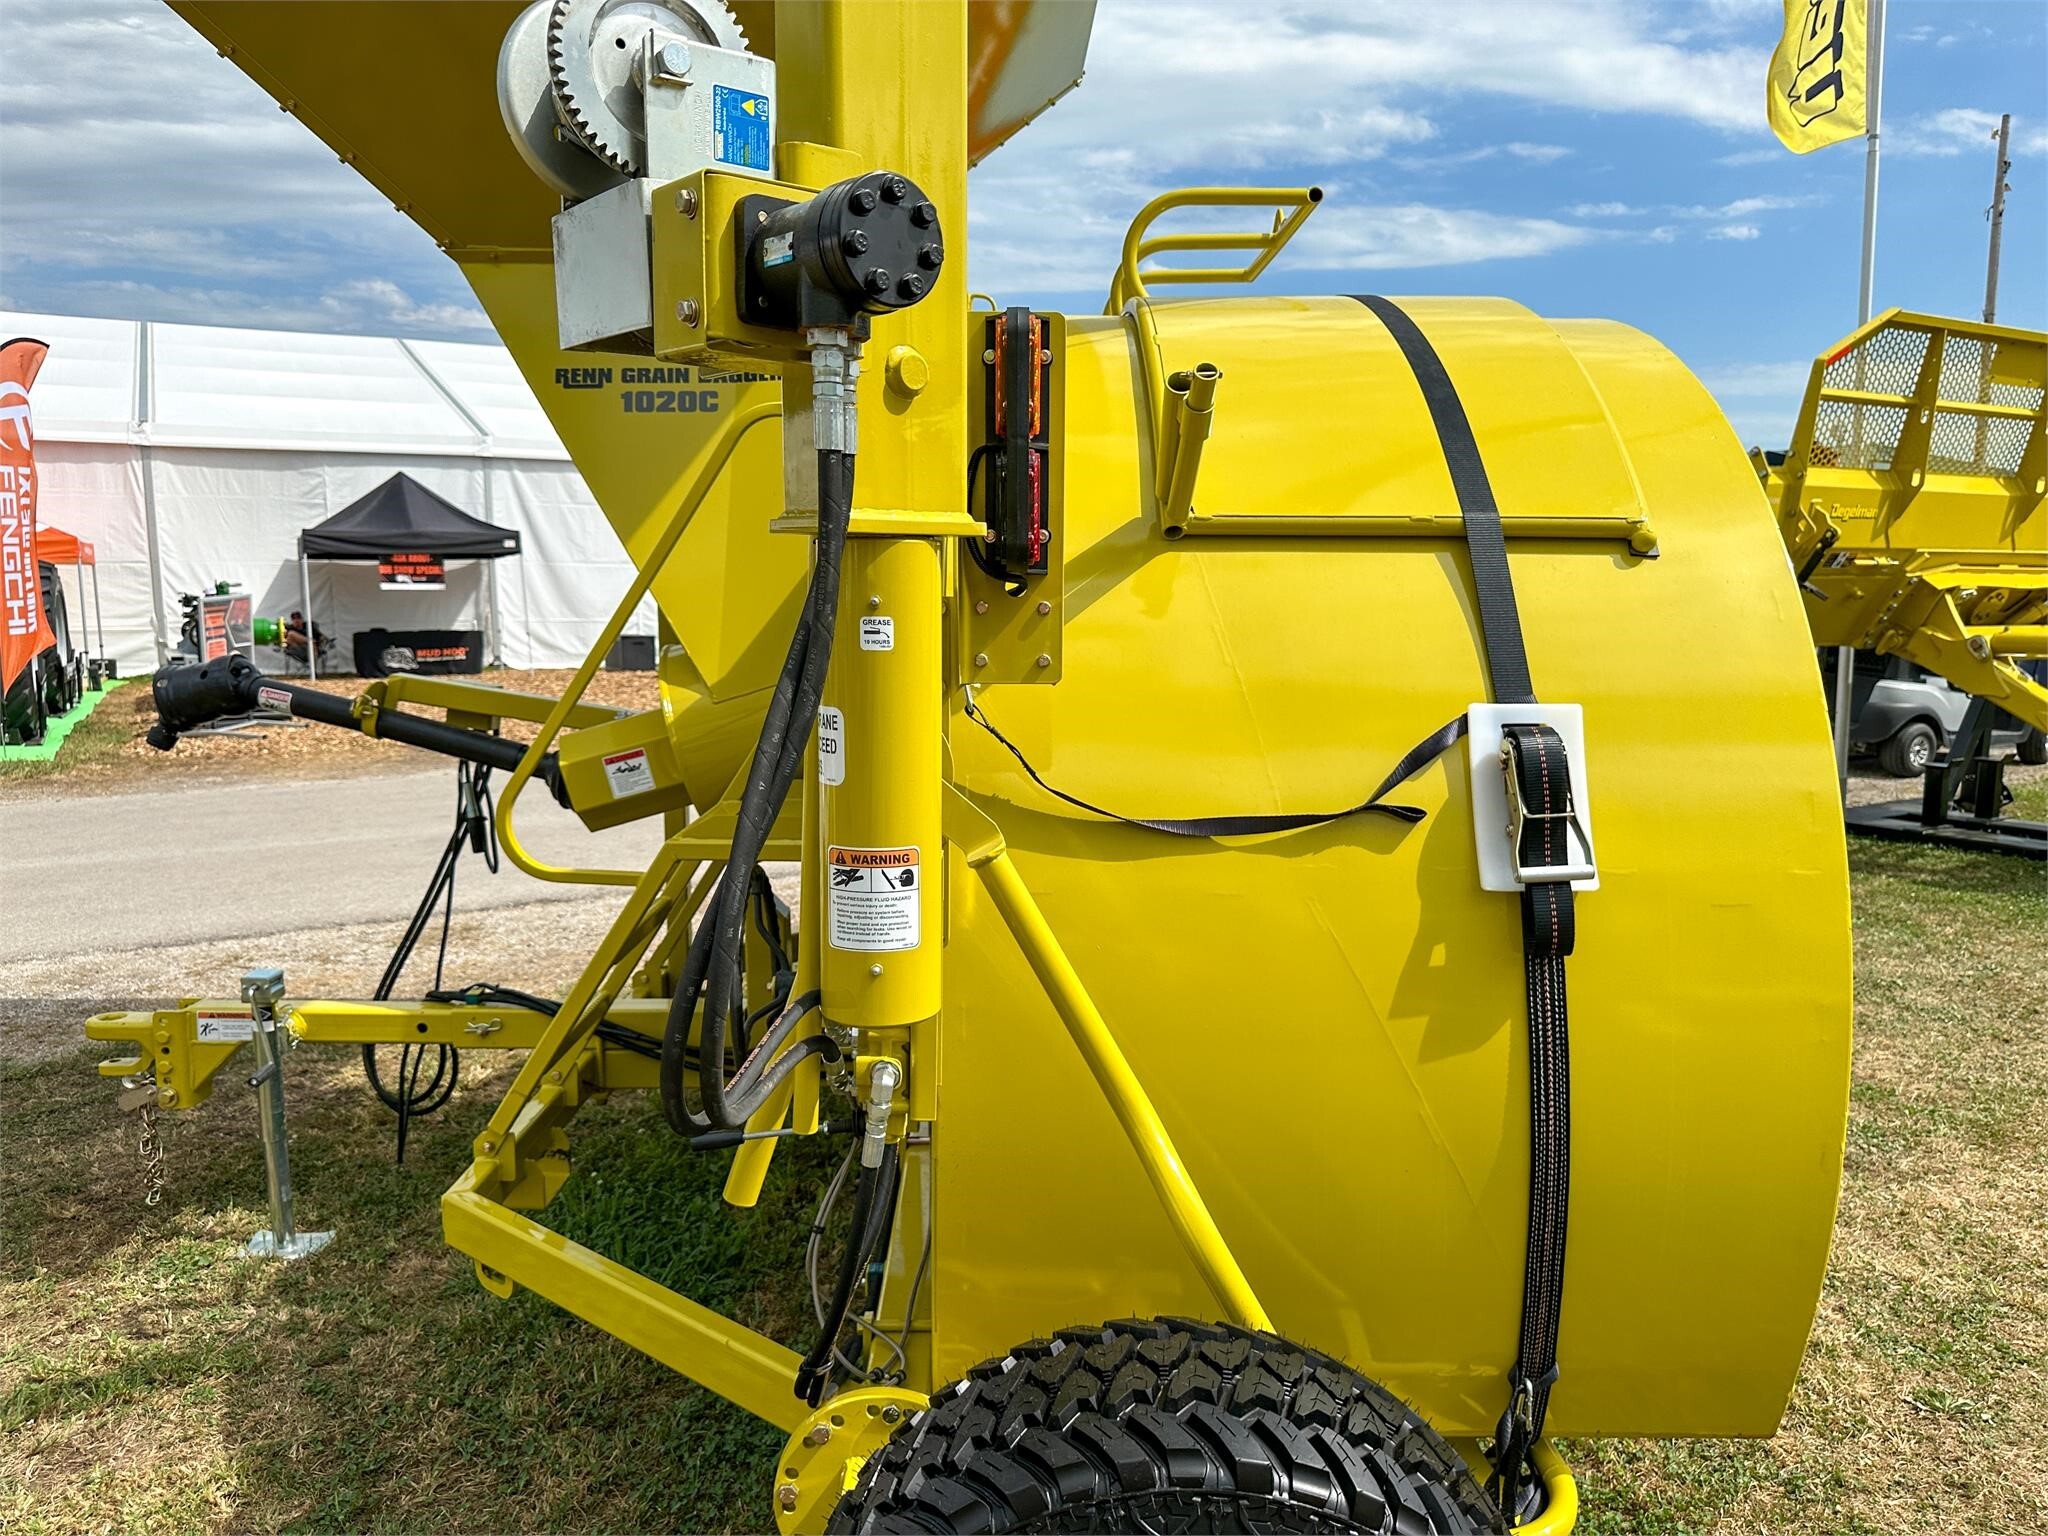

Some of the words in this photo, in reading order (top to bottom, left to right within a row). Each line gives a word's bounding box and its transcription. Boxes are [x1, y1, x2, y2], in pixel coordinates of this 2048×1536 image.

[555, 367, 613, 389] RENN
[621, 367, 689, 384] GRAIN
[620, 391, 719, 413] 1020C
[0, 465, 27, 636] FENGCHI
[416, 648, 441, 657] MUD
[819, 736, 837, 754] EED
[850, 853, 910, 865] WARNING
